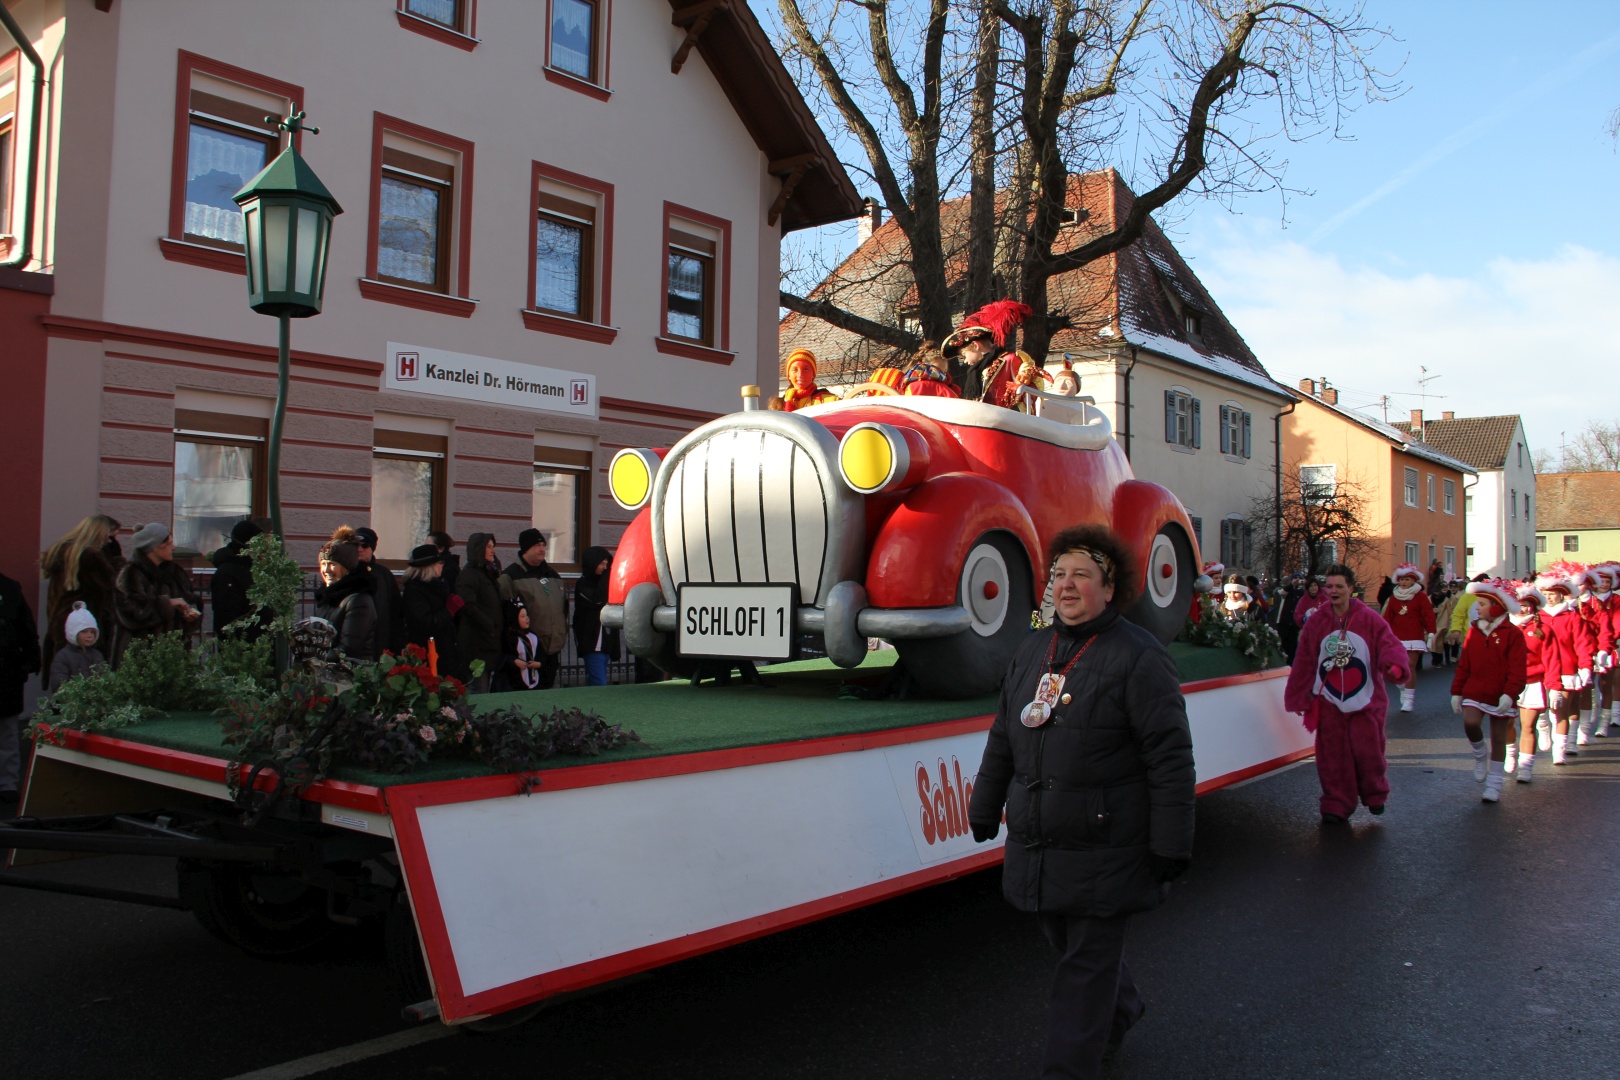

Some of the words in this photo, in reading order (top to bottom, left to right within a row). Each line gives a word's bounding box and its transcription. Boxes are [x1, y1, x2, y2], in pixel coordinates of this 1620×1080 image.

[400, 356, 415, 377] H
[426, 363, 479, 385] Kanzlei
[483, 372, 502, 389] Dr.
[506, 375, 565, 398] Hörmann
[573, 383, 585, 401] H
[686, 606, 765, 637] SCHLOFI
[776, 607, 784, 638] 1
